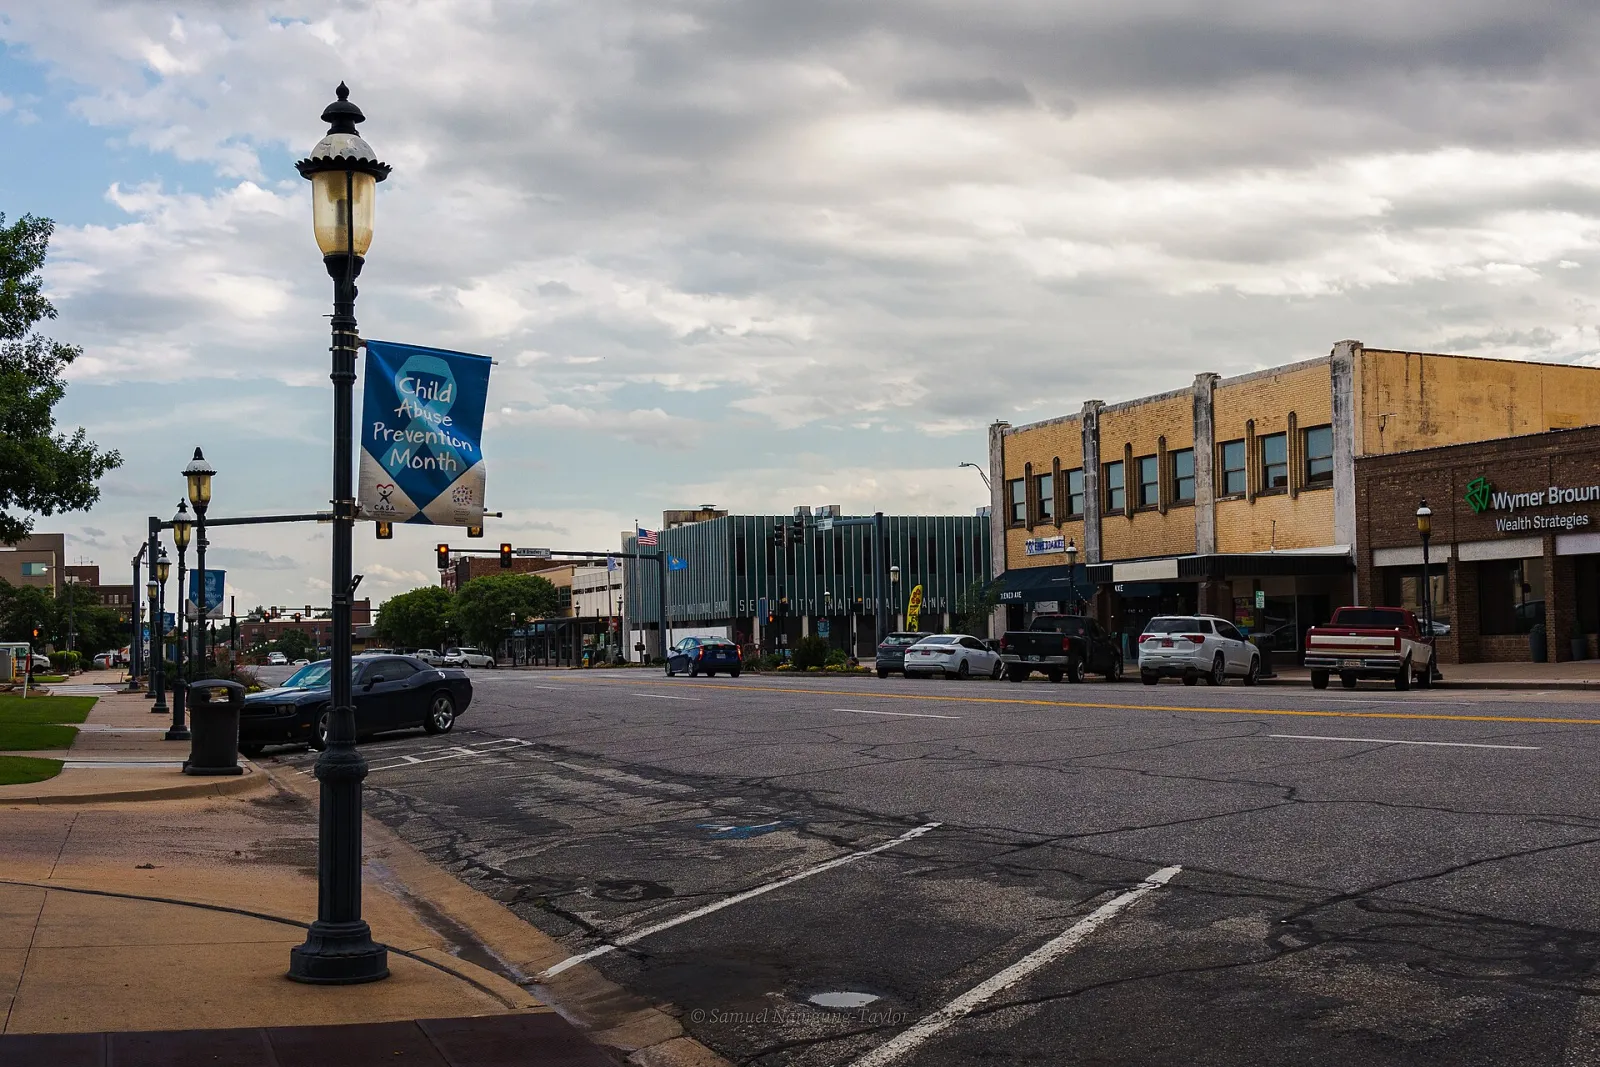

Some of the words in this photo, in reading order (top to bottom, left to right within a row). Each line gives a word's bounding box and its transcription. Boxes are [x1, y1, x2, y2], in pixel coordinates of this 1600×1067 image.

[399, 377, 453, 403] Child
[394, 398, 453, 427] Abuse
[373, 422, 473, 452] Prevention
[390, 448, 457, 472] Month
[374, 504, 396, 512] CASA
[1492, 491, 1545, 513] Wymer
[1548, 485, 1600, 505] Brown
[1496, 516, 1532, 532] Wealth
[1533, 512, 1589, 530] Strategies
[739, 598, 814, 612] SEUITY
[827, 597, 899, 611] NATONAL
